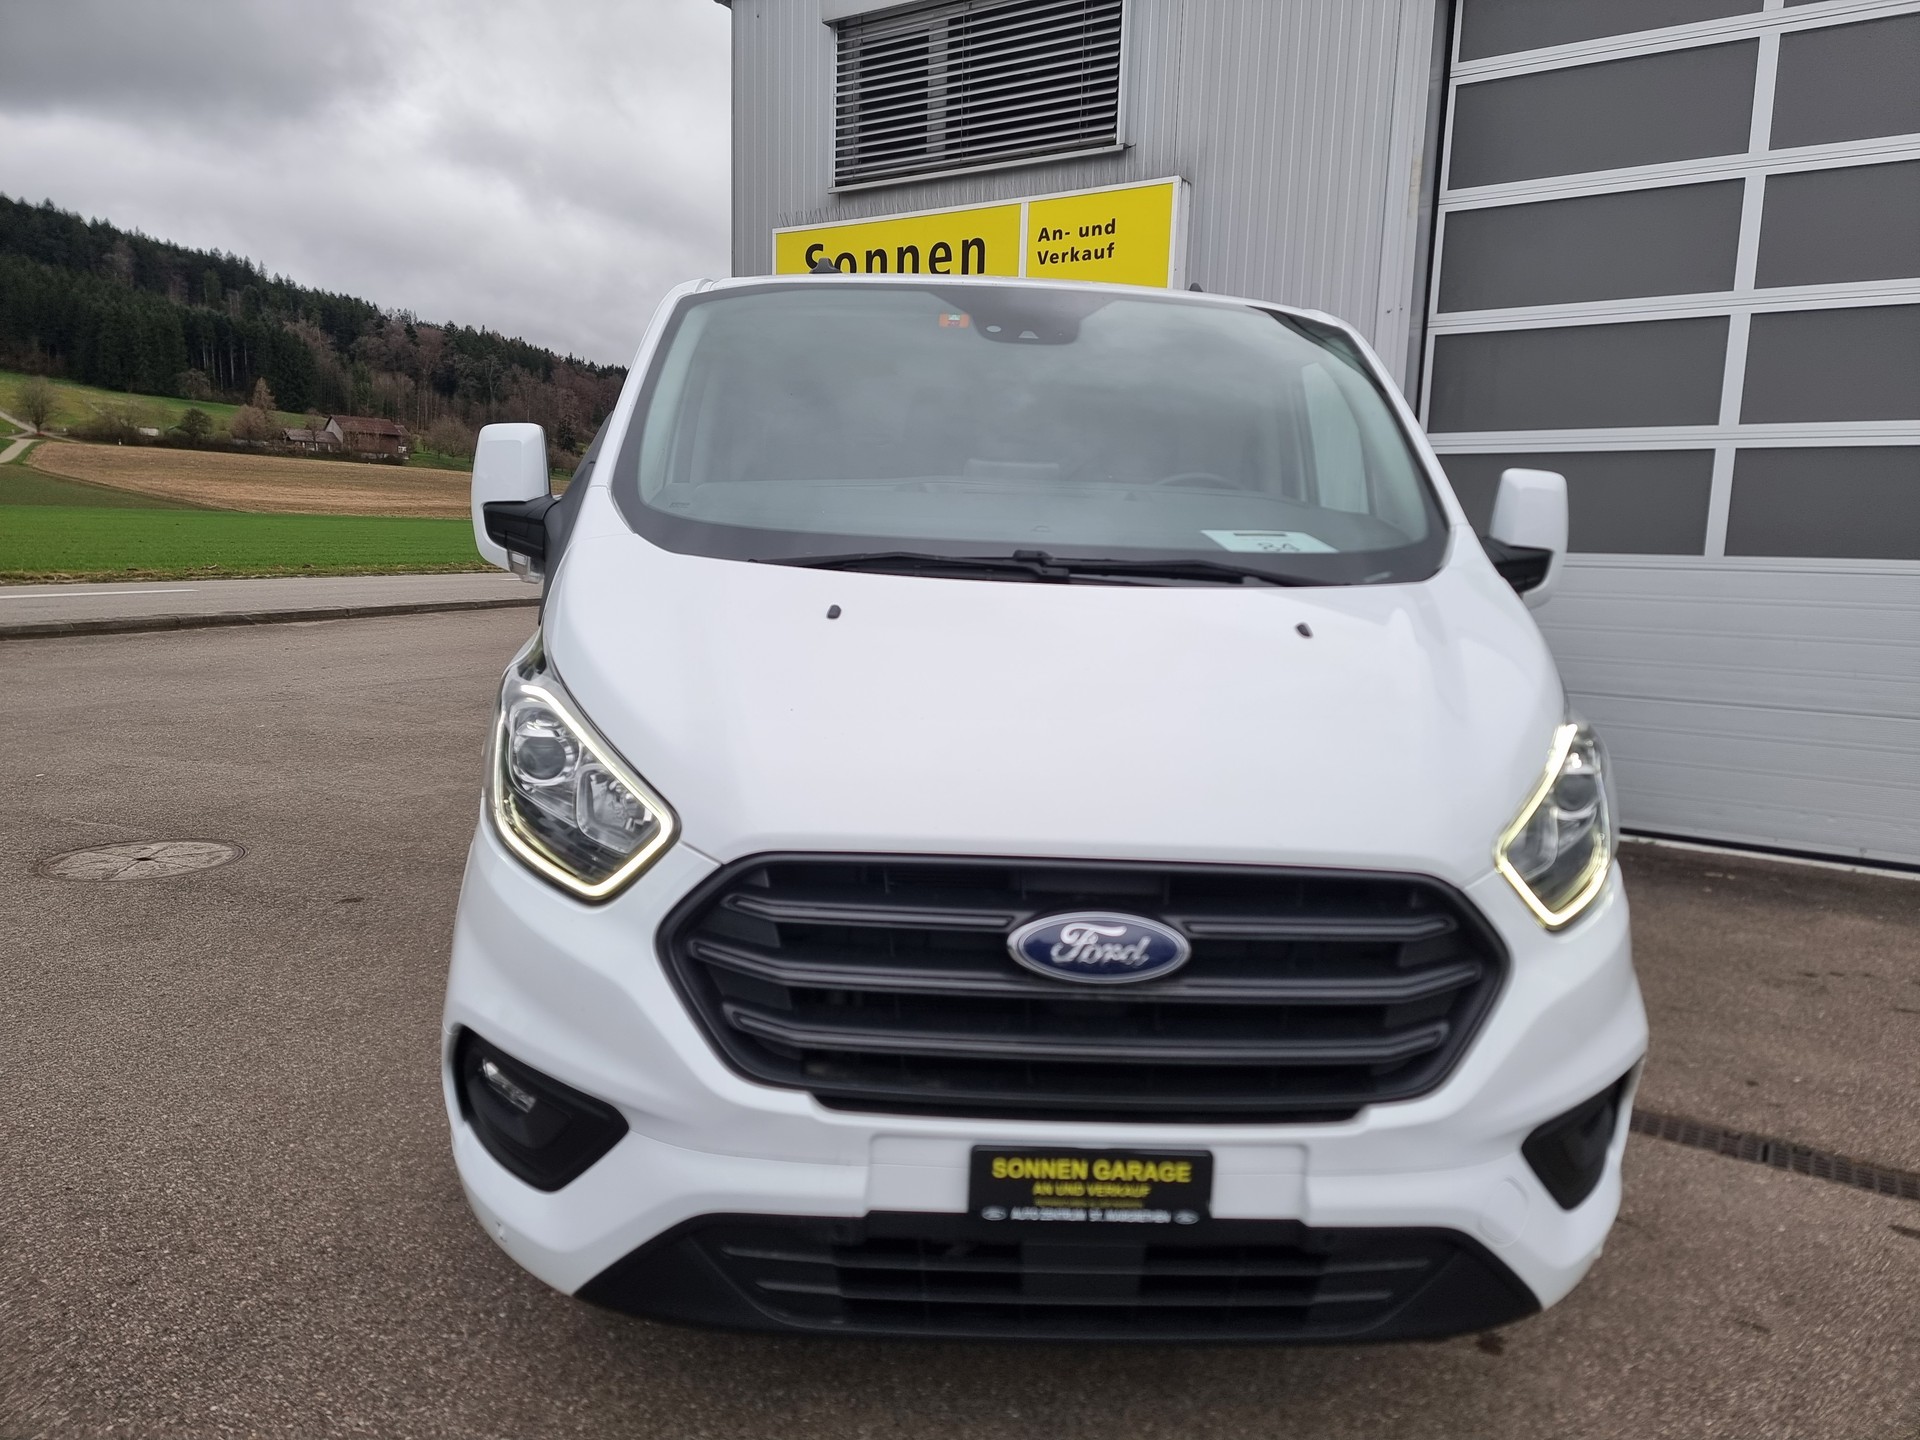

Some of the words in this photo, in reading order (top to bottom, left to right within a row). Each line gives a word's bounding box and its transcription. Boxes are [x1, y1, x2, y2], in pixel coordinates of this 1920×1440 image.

[1037, 227, 1071, 242] An-
[1079, 218, 1116, 238] und
[1037, 242, 1115, 265] Verkauf
[1051, 922, 1151, 967] Ford
[992, 1157, 1089, 1180] SONNEN
[1092, 1159, 1193, 1183] GARAGE
